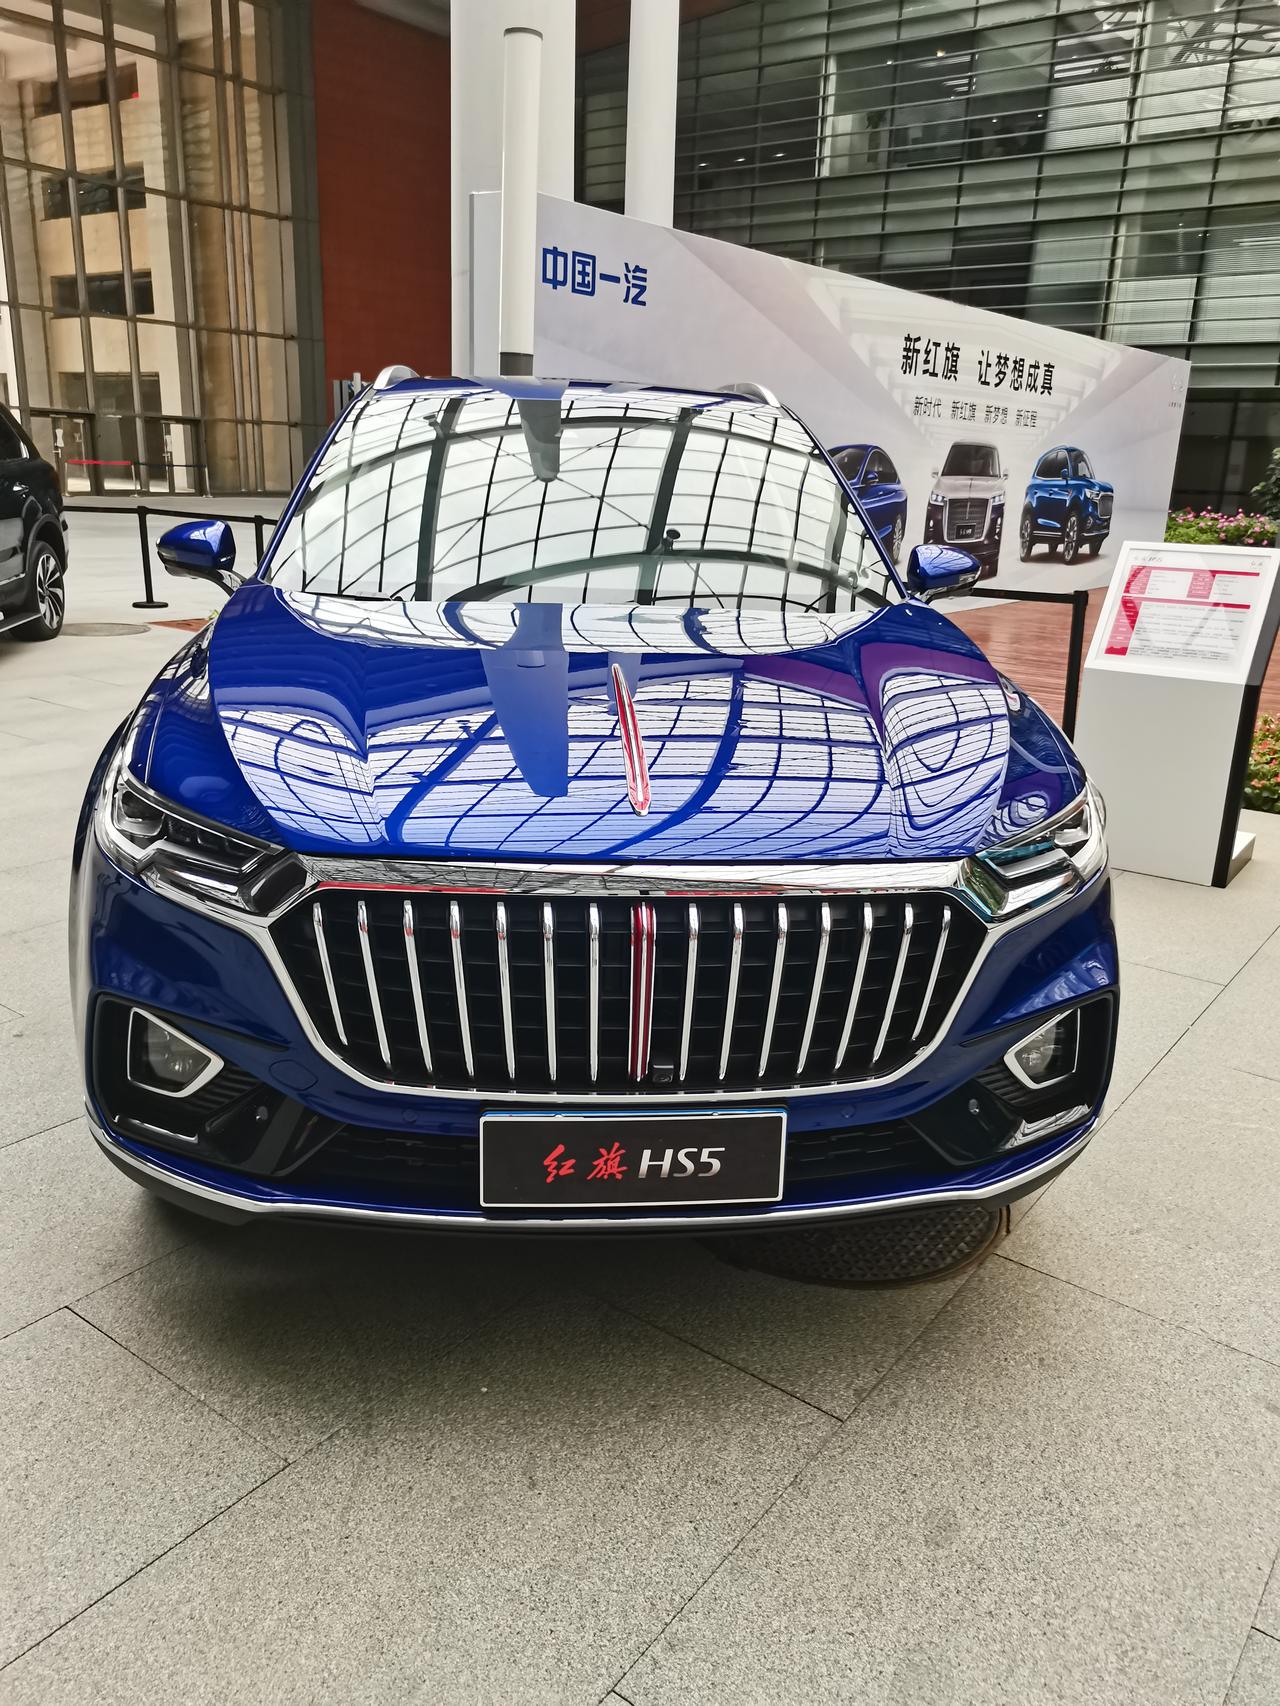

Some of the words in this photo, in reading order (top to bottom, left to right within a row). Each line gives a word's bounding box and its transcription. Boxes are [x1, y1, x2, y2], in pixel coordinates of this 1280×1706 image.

[542, 246, 648, 307] 中国一汽
[901, 333, 961, 382] 新红旗
[977, 349, 1055, 396] 让梦想成真
[912, 396, 942, 418] 新时代
[950, 400, 977, 422] 新红旗
[983, 404, 1009, 425] 新梦想
[543, 1141, 629, 1184] 红旗
[637, 1146, 726, 1179] HS5
